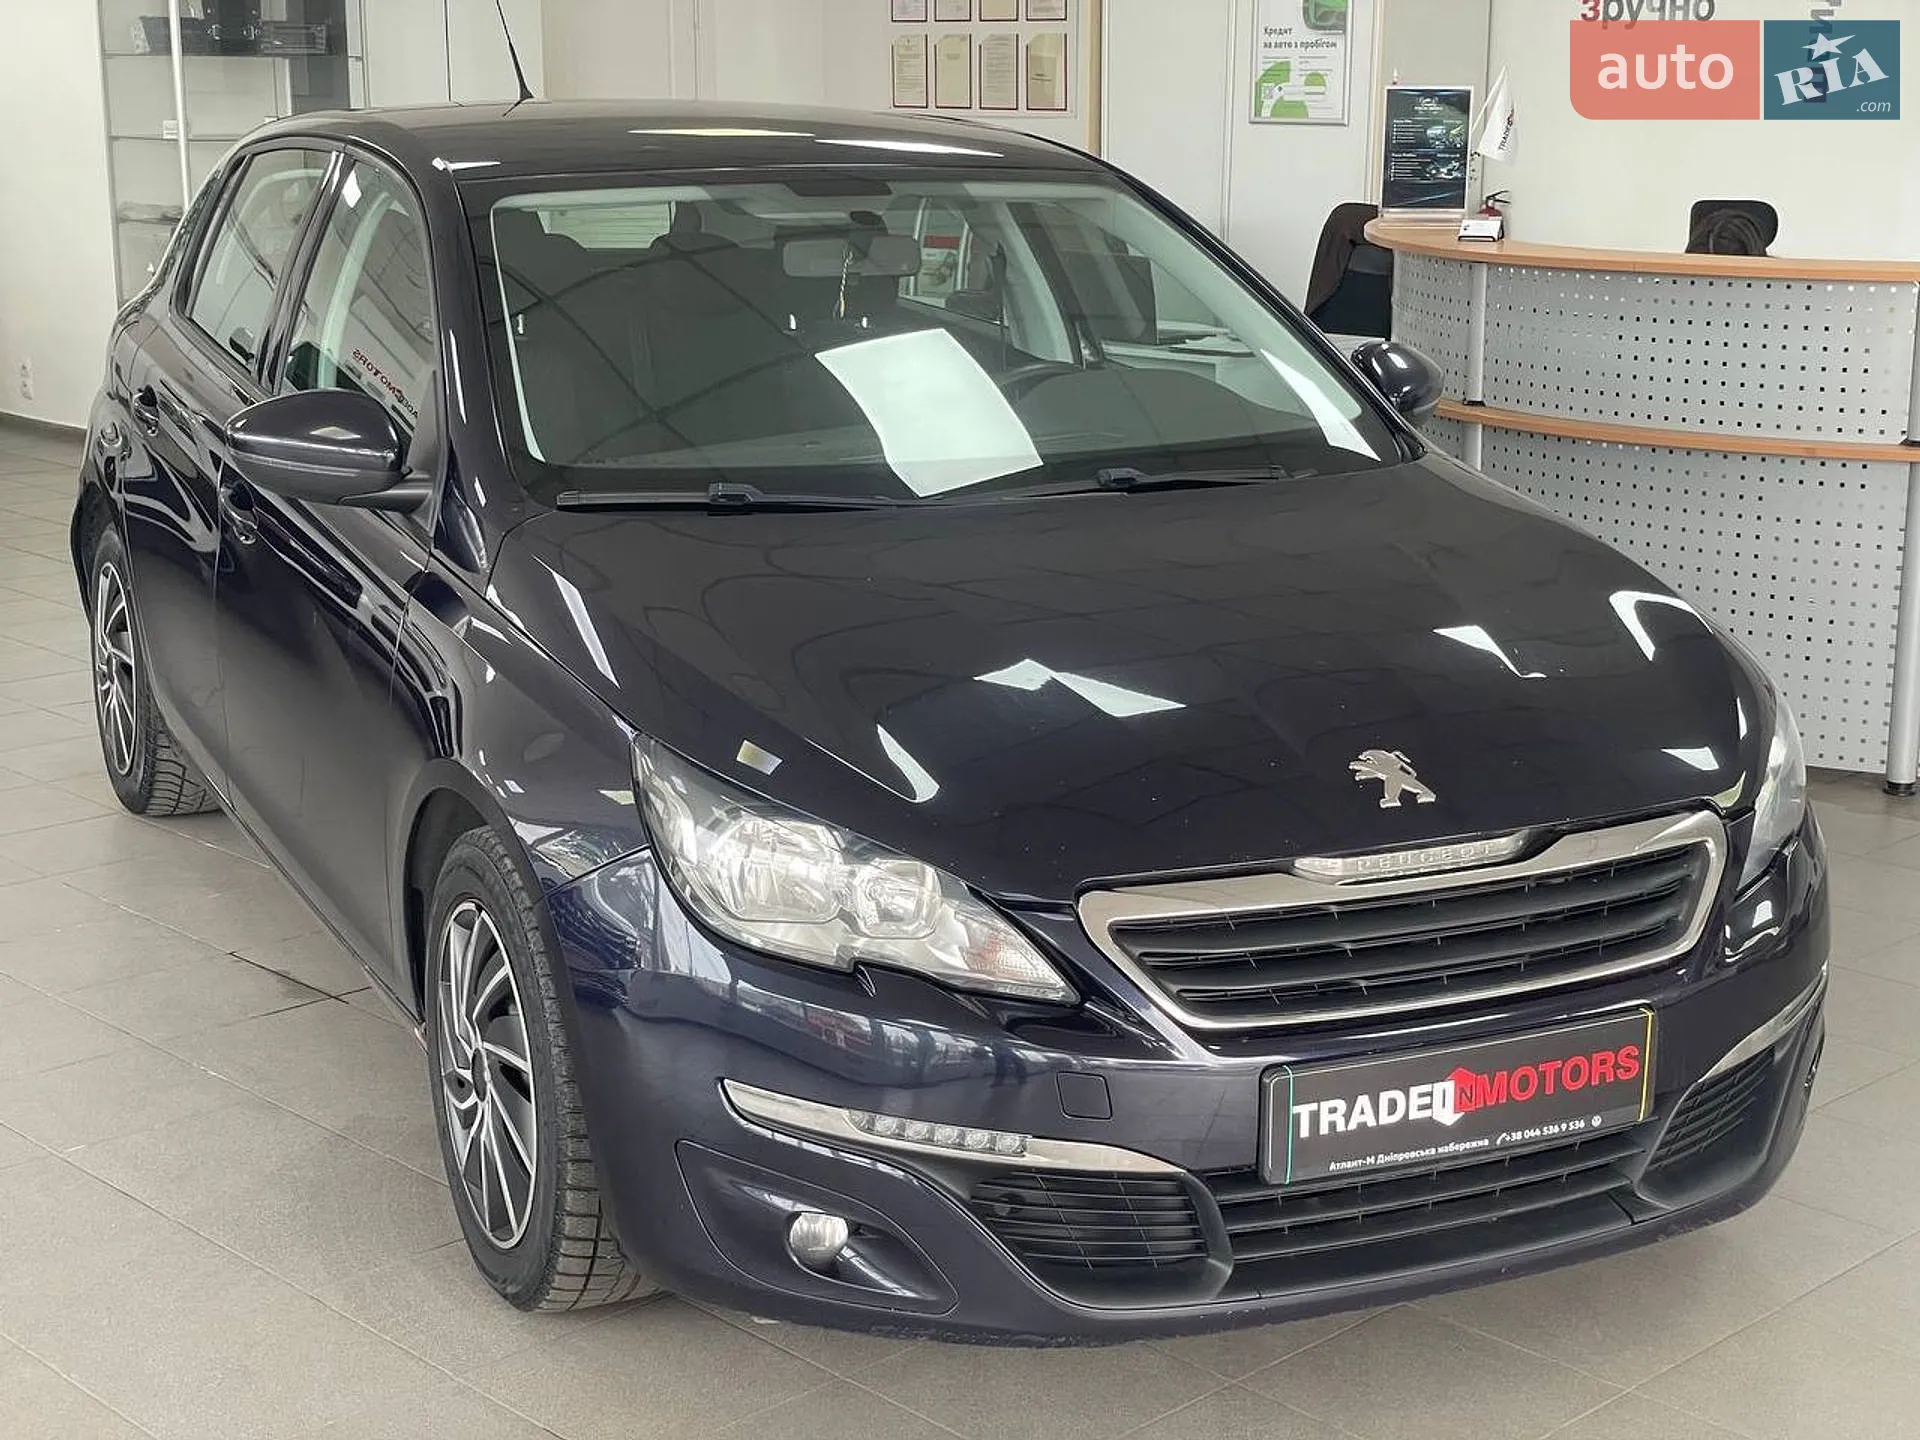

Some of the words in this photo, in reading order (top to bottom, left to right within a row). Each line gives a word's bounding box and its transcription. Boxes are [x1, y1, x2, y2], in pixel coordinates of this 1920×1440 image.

[1263, 27, 1292, 37] Кредит
[1357, 845, 1490, 871] PEUGEOT
[1437, 1138, 1489, 1154] набережна
[1568, 1119, 1586, 1131] 536
